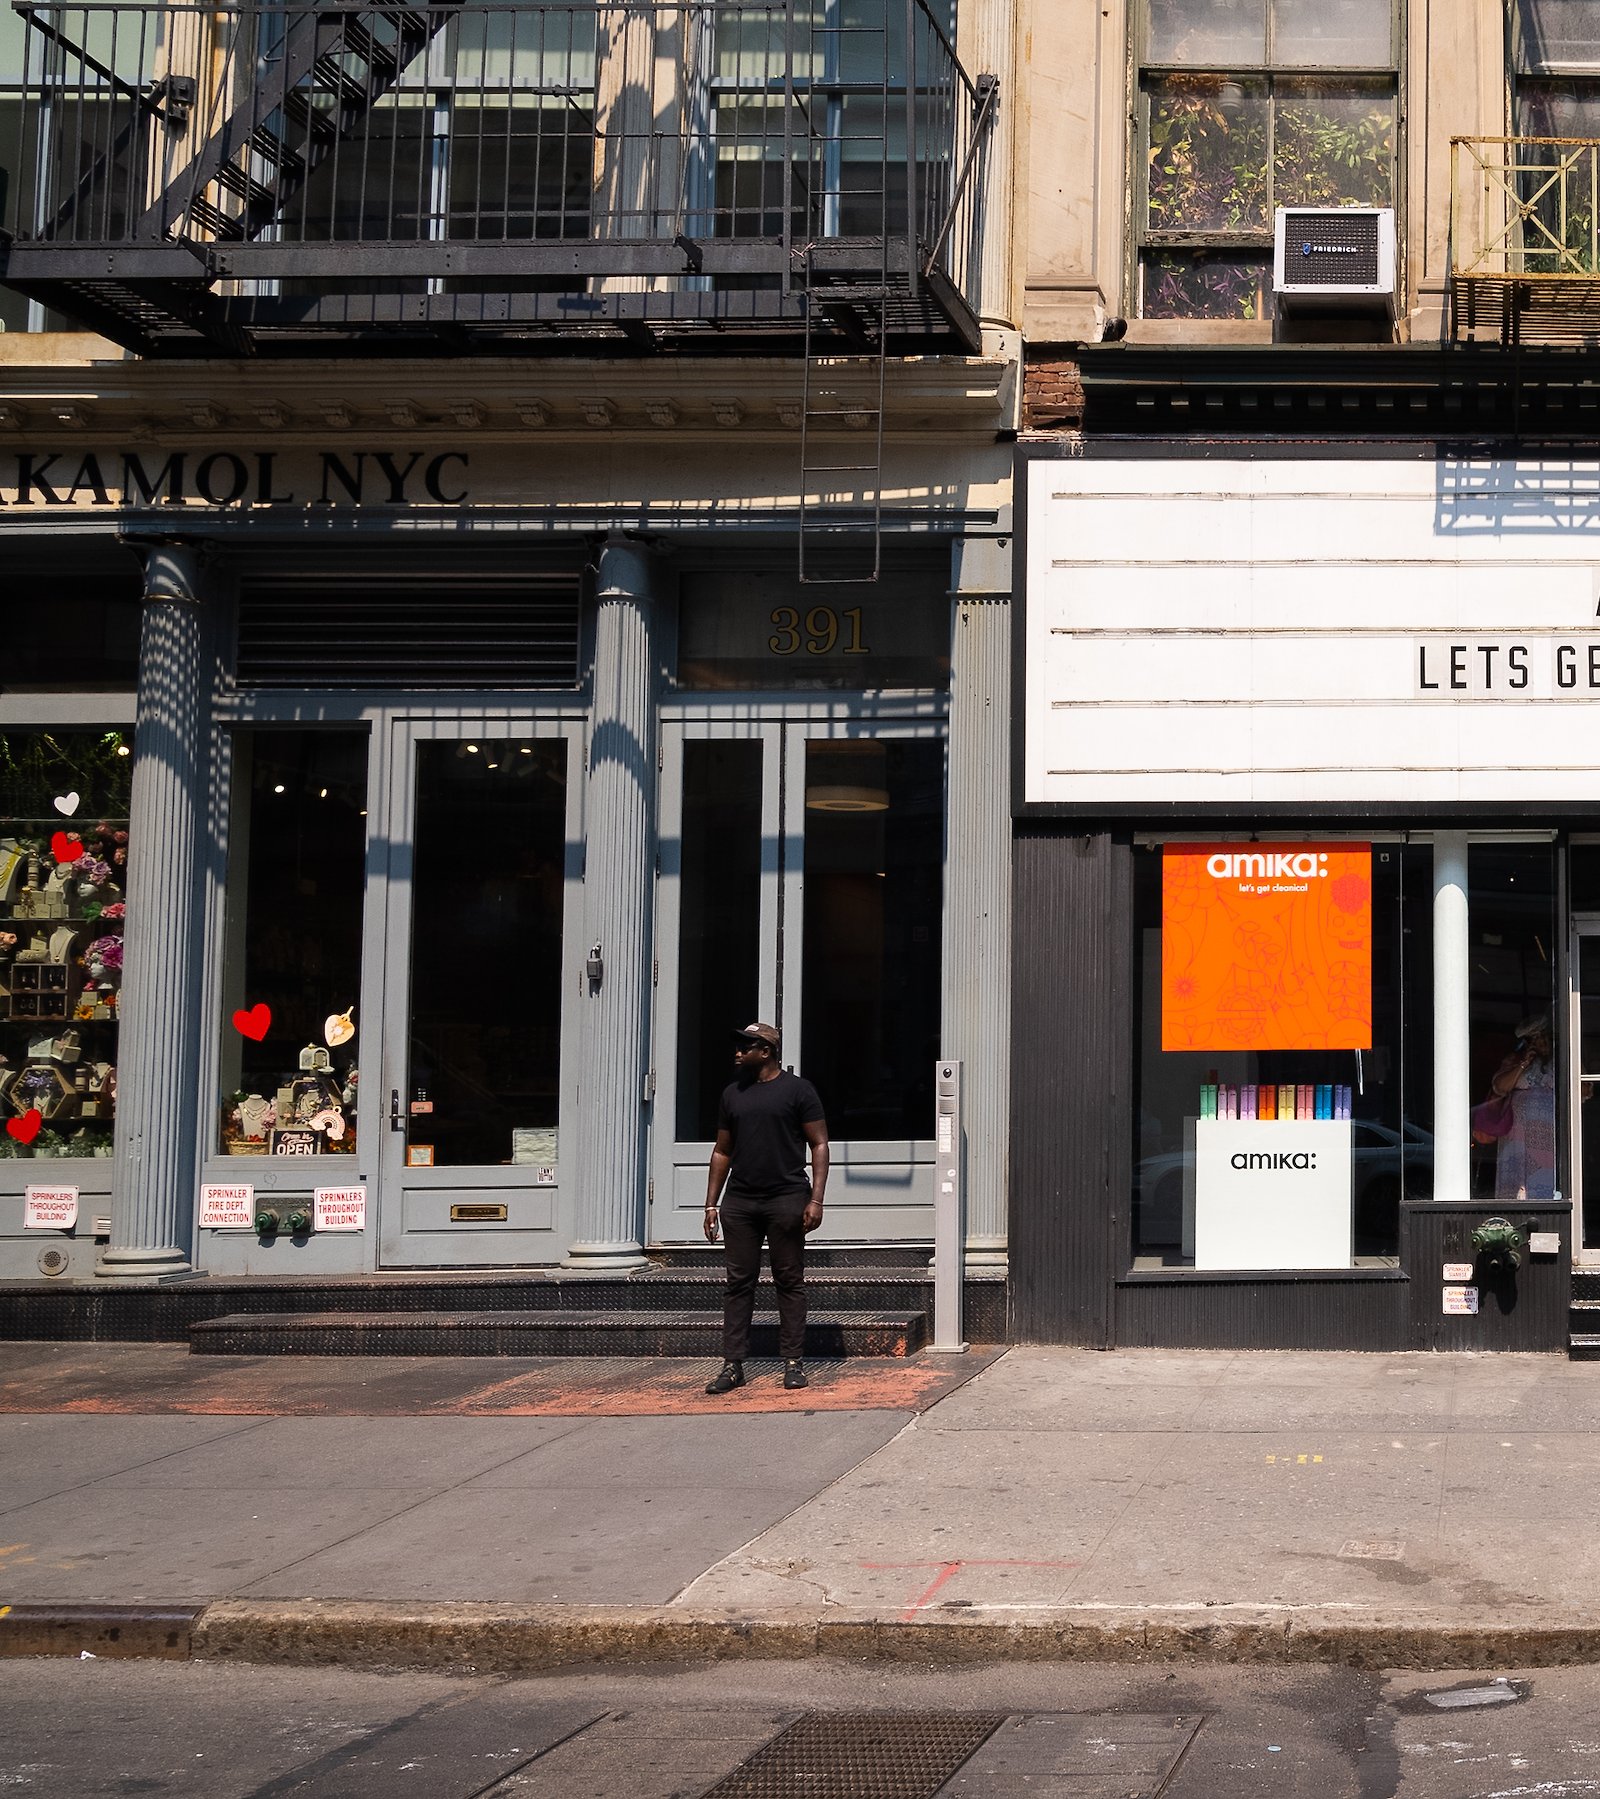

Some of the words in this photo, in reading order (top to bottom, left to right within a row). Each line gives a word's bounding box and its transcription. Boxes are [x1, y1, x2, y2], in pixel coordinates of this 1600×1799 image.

[1313, 245, 1357, 253] FRIEDRICH
[0, 451, 294, 506] KAMOL
[317, 451, 471, 505] NYC
[768, 605, 870, 655] 391
[1418, 644, 1530, 692] LETS
[1206, 852, 1328, 878] amika:
[1239, 883, 1255, 892] let's
[1257, 883, 1270, 894] get
[1272, 883, 1308, 892] cleanical
[276, 1143, 314, 1156] OPEN
[1230, 1152, 1317, 1170] amika:
[31, 1192, 73, 1201] SPRINKLERS
[207, 1189, 248, 1199] SPRINKLER
[319, 1192, 363, 1203] SPRINKLERS
[29, 1202, 75, 1211] THROUGHOUT
[208, 1201, 225, 1211] FIRE
[226, 1201, 246, 1211] DEPT.
[318, 1203, 364, 1214] THROUGHOUT
[36, 1212, 67, 1221] BUILDING
[203, 1213, 250, 1223] CONNECTION
[325, 1215, 358, 1225] BUILDING
